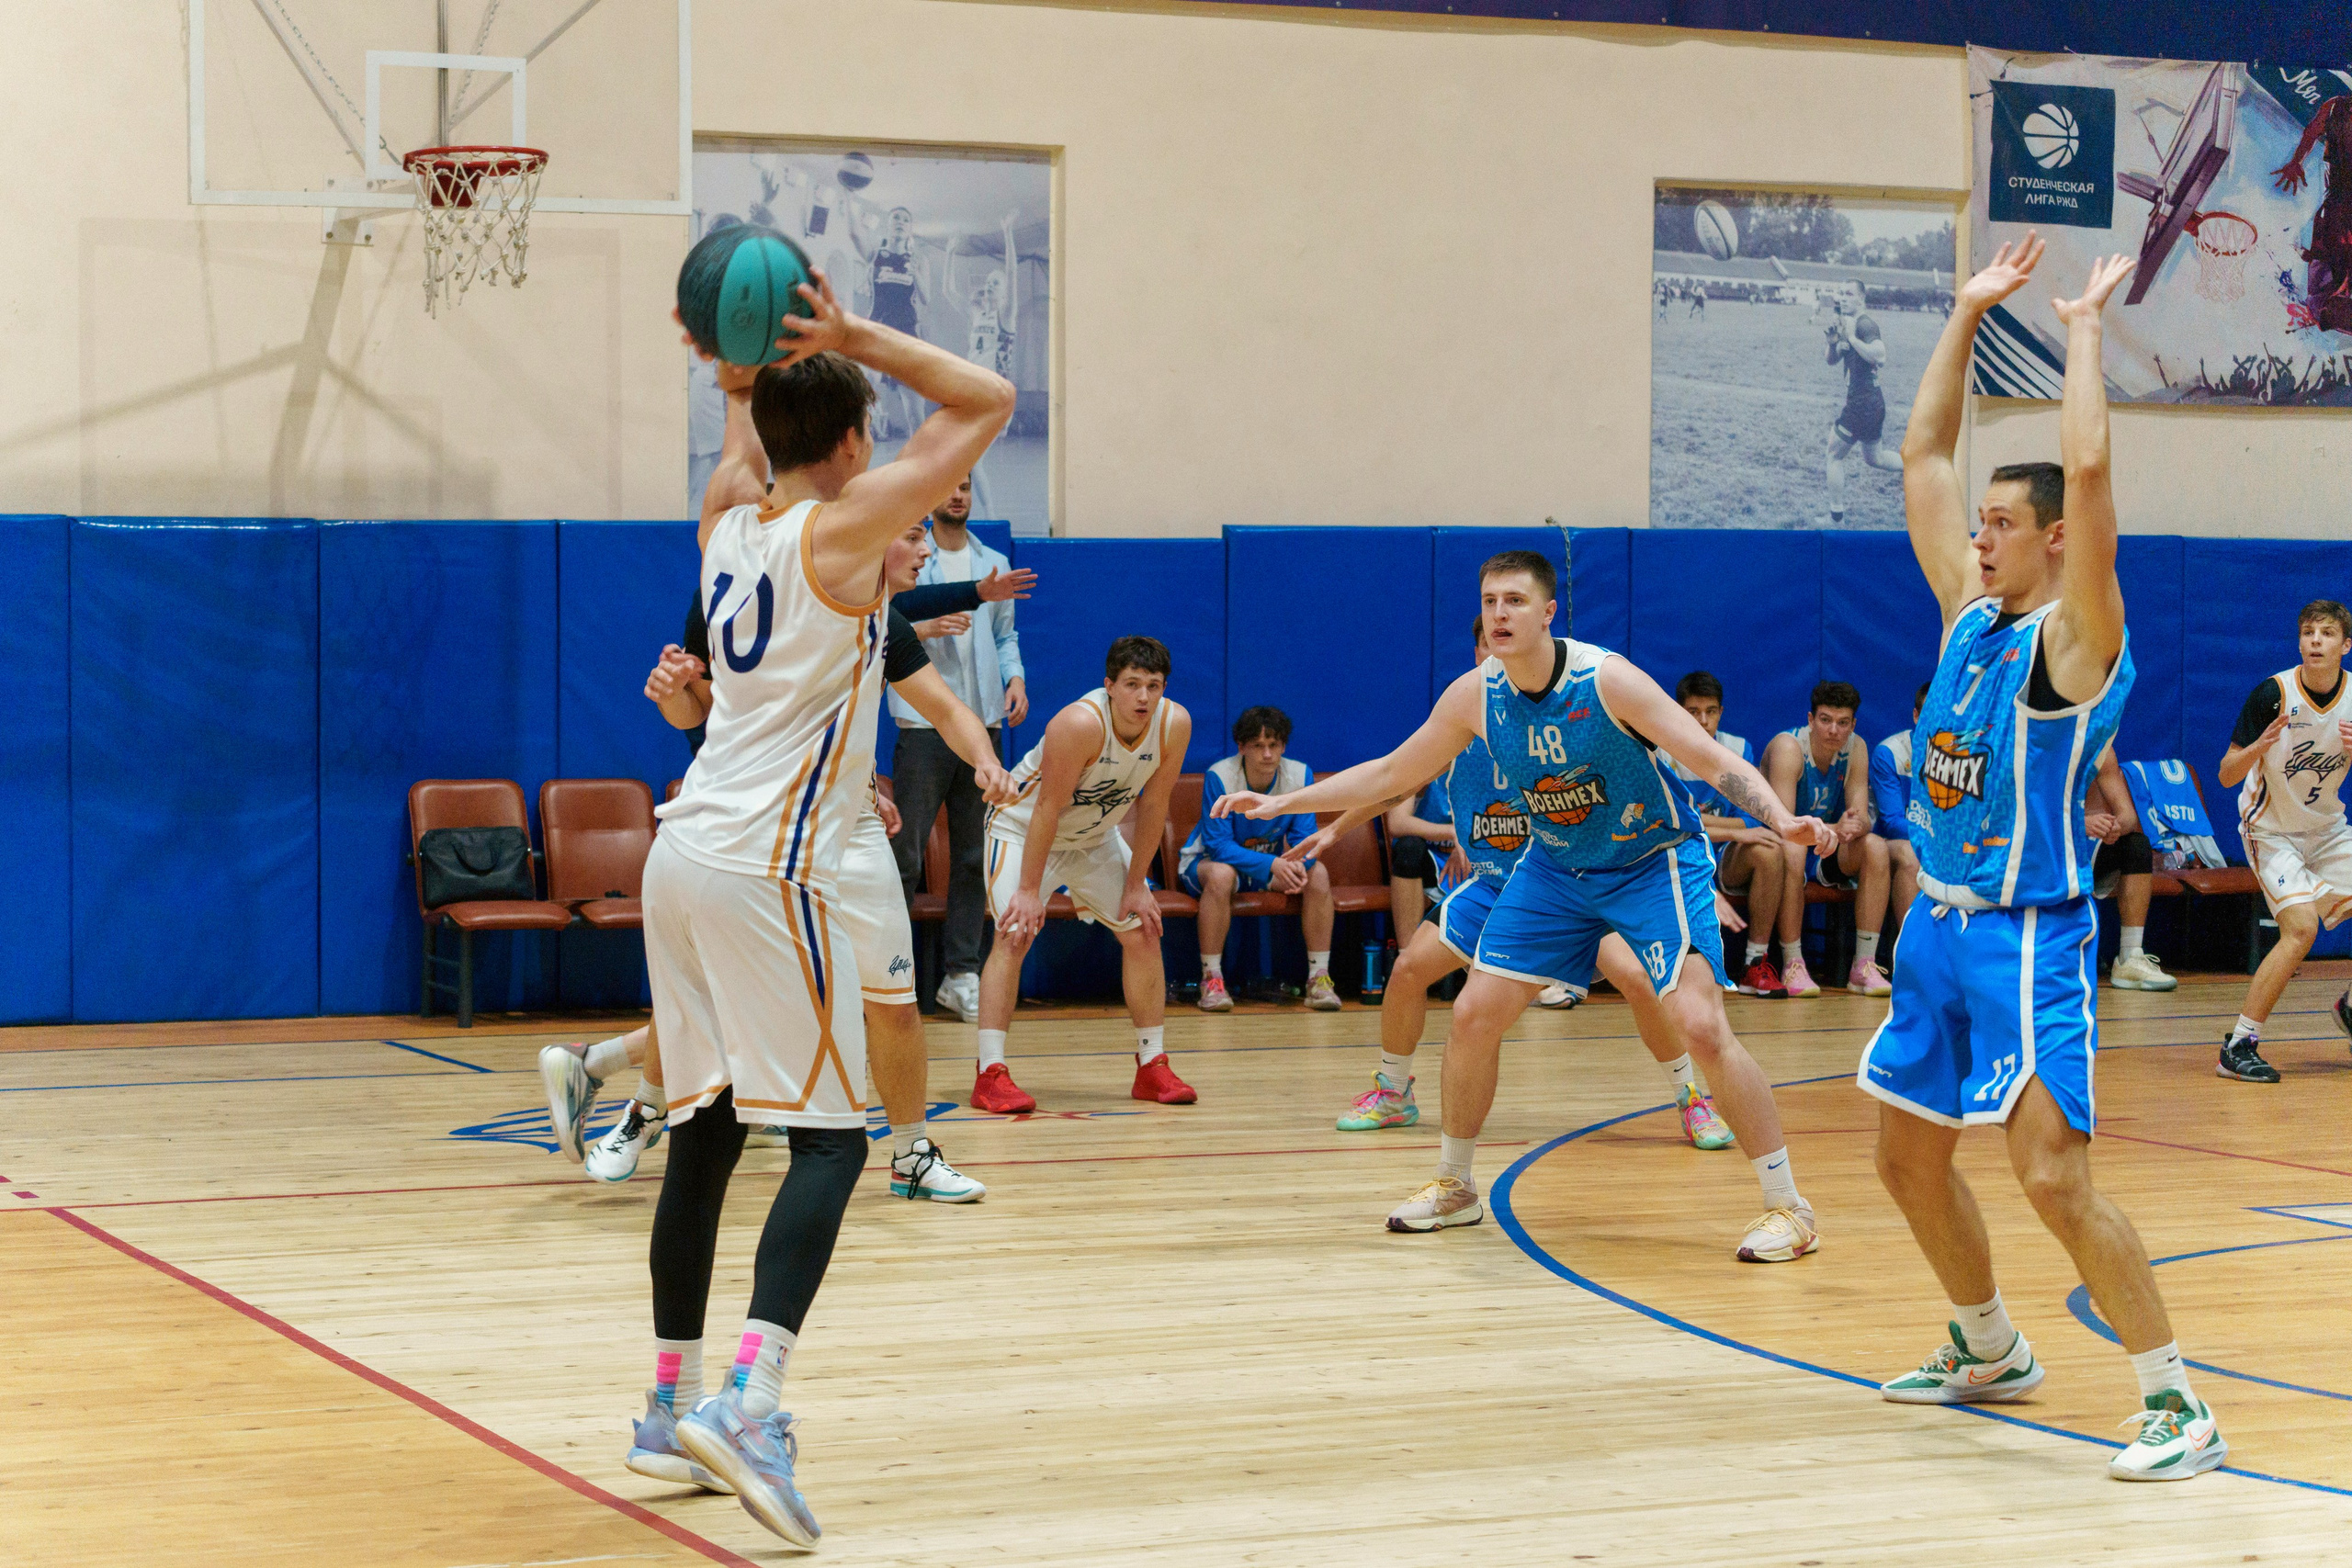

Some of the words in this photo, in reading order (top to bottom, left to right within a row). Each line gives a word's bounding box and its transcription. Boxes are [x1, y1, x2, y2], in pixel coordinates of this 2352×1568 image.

[2007, 176, 2095, 194] СТУДЕНЧЕСКАЯ
[2024, 193, 2056, 206] ЛИГА
[2056, 196, 2079, 209] РЖД
[707, 571, 775, 674] 10
[1528, 725, 1567, 765] 48
[1810, 787, 1829, 810] 12
[2304, 786, 2323, 806] 5
[1973, 1053, 2016, 1101] 17
